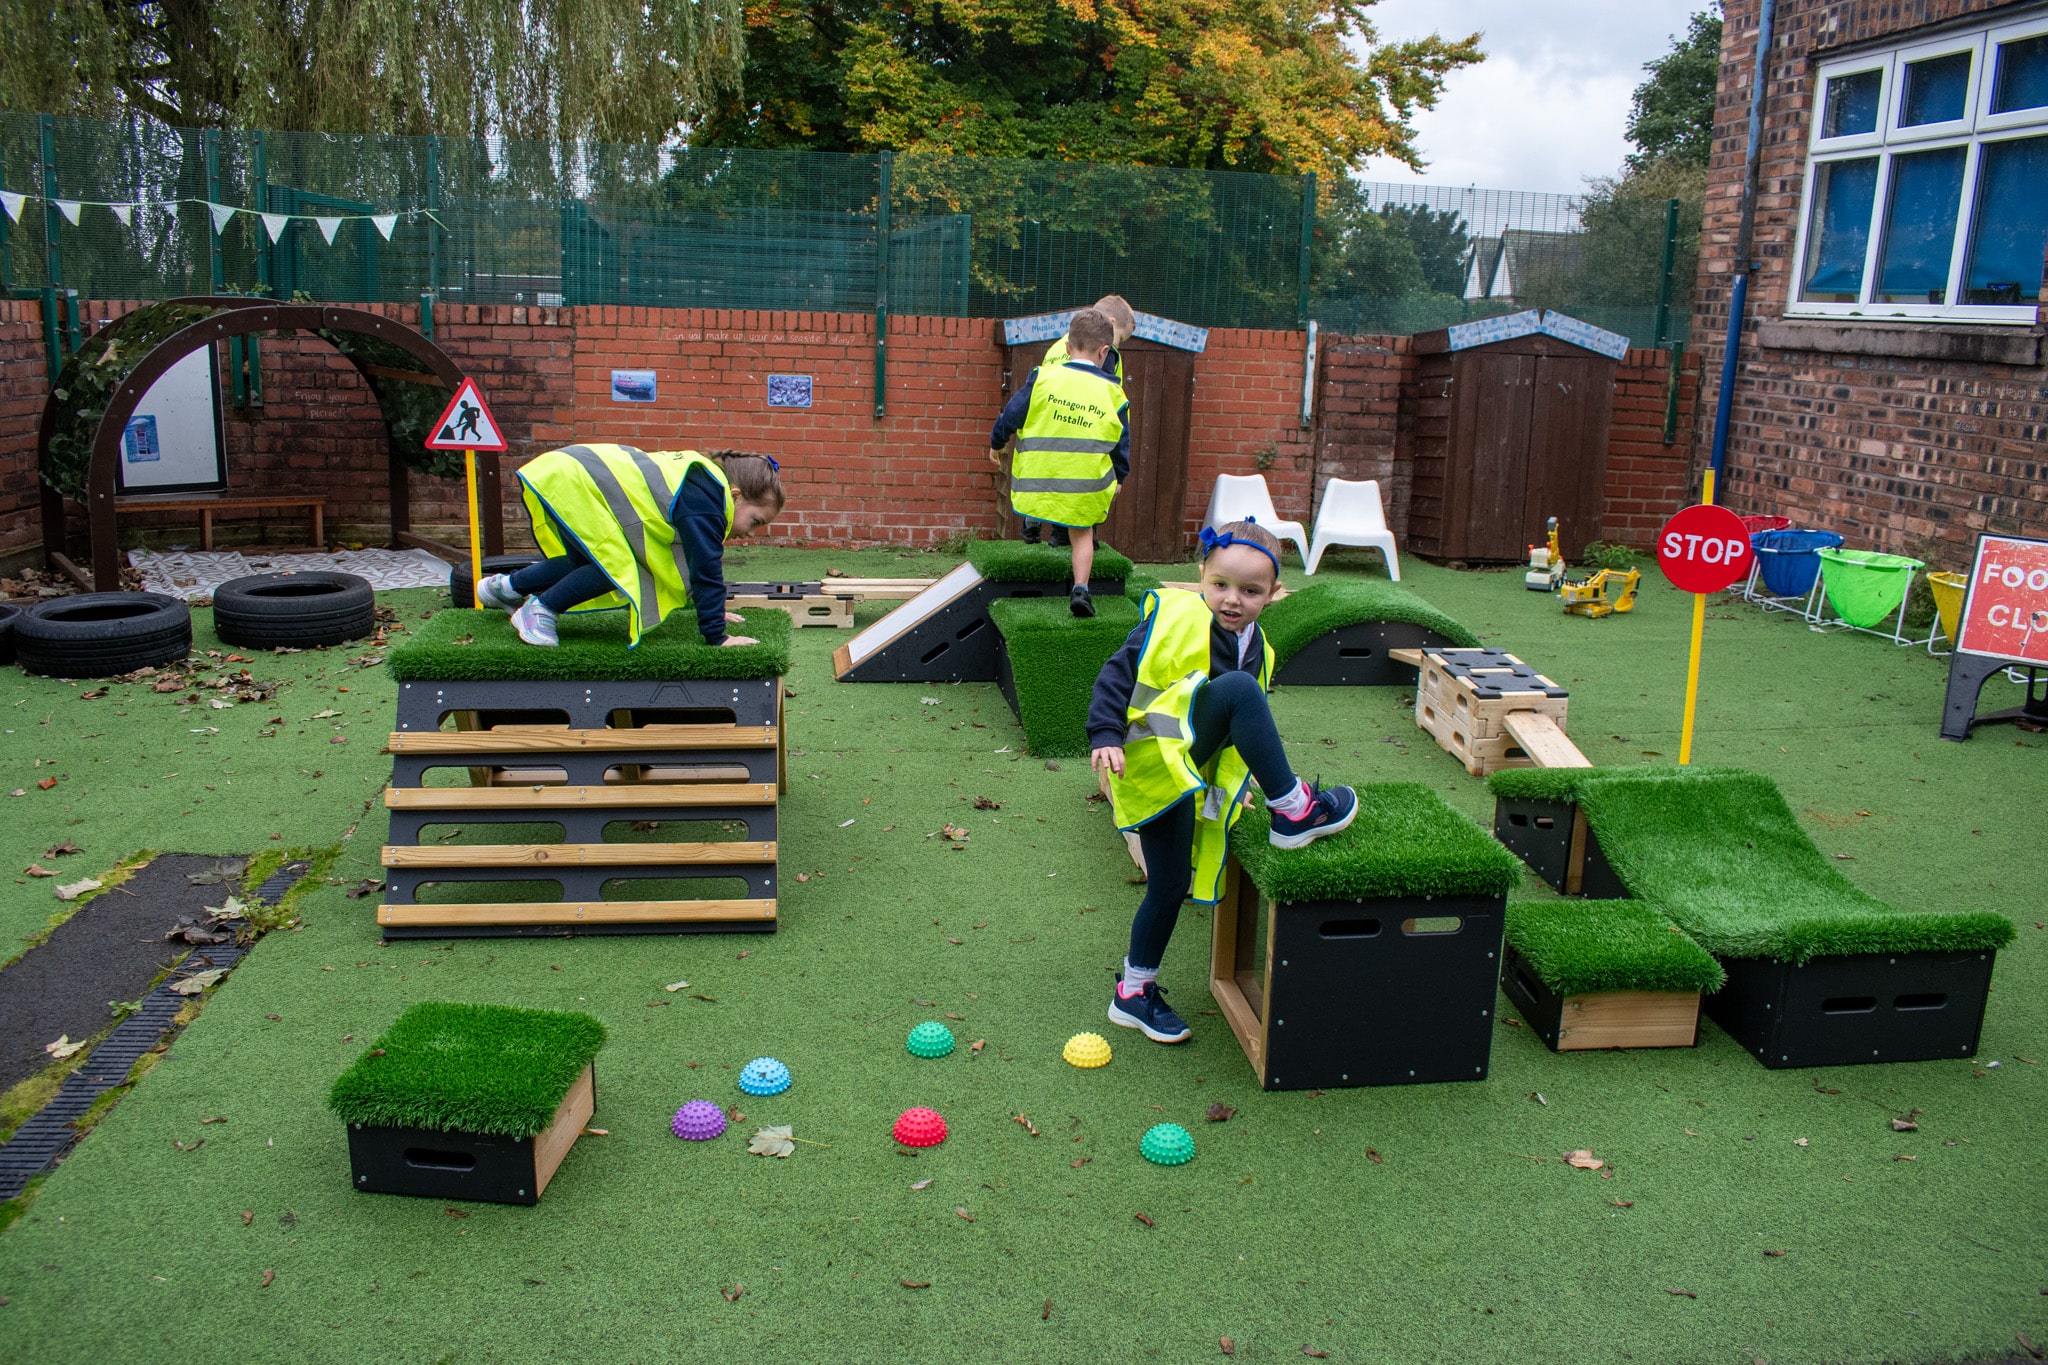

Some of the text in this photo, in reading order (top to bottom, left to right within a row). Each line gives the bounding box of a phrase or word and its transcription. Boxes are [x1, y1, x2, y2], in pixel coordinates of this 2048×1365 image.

[1031, 323, 1056, 332] Music
[666, 330, 685, 341] Can
[688, 333, 701, 342] you
[706, 330, 729, 341] make
[733, 331, 744, 342] up
[749, 333, 769, 343] your
[295, 391, 351, 403] Enjoy your
[1047, 394, 1107, 419] Pentagon Play
[1053, 410, 1094, 429] Installer
[1662, 532, 1745, 566] STOP
